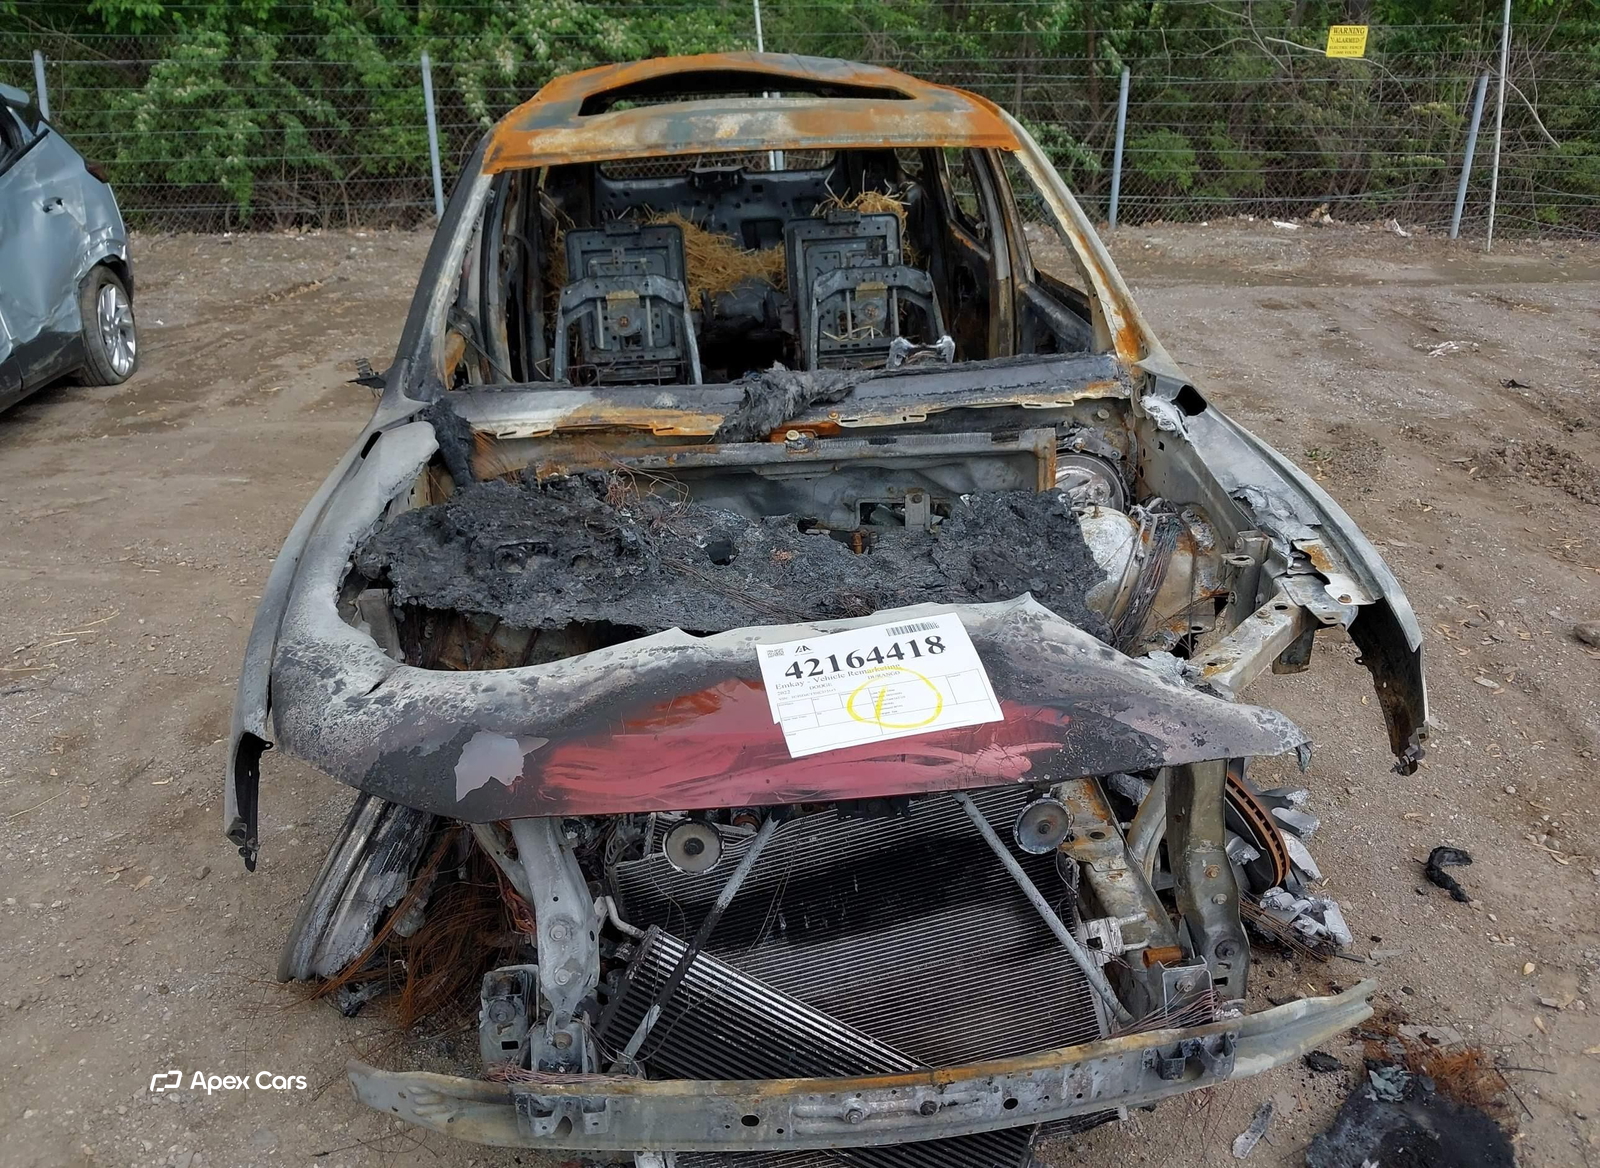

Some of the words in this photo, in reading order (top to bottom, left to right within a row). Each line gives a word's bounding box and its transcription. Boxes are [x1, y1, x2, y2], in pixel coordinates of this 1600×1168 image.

[784, 635, 946, 680] 42164418
[775, 680, 805, 690] Emkay
[812, 673, 846, 683] Vehicle
[847, 663, 901, 677] Remarketing
[809, 683, 833, 691] DODGE
